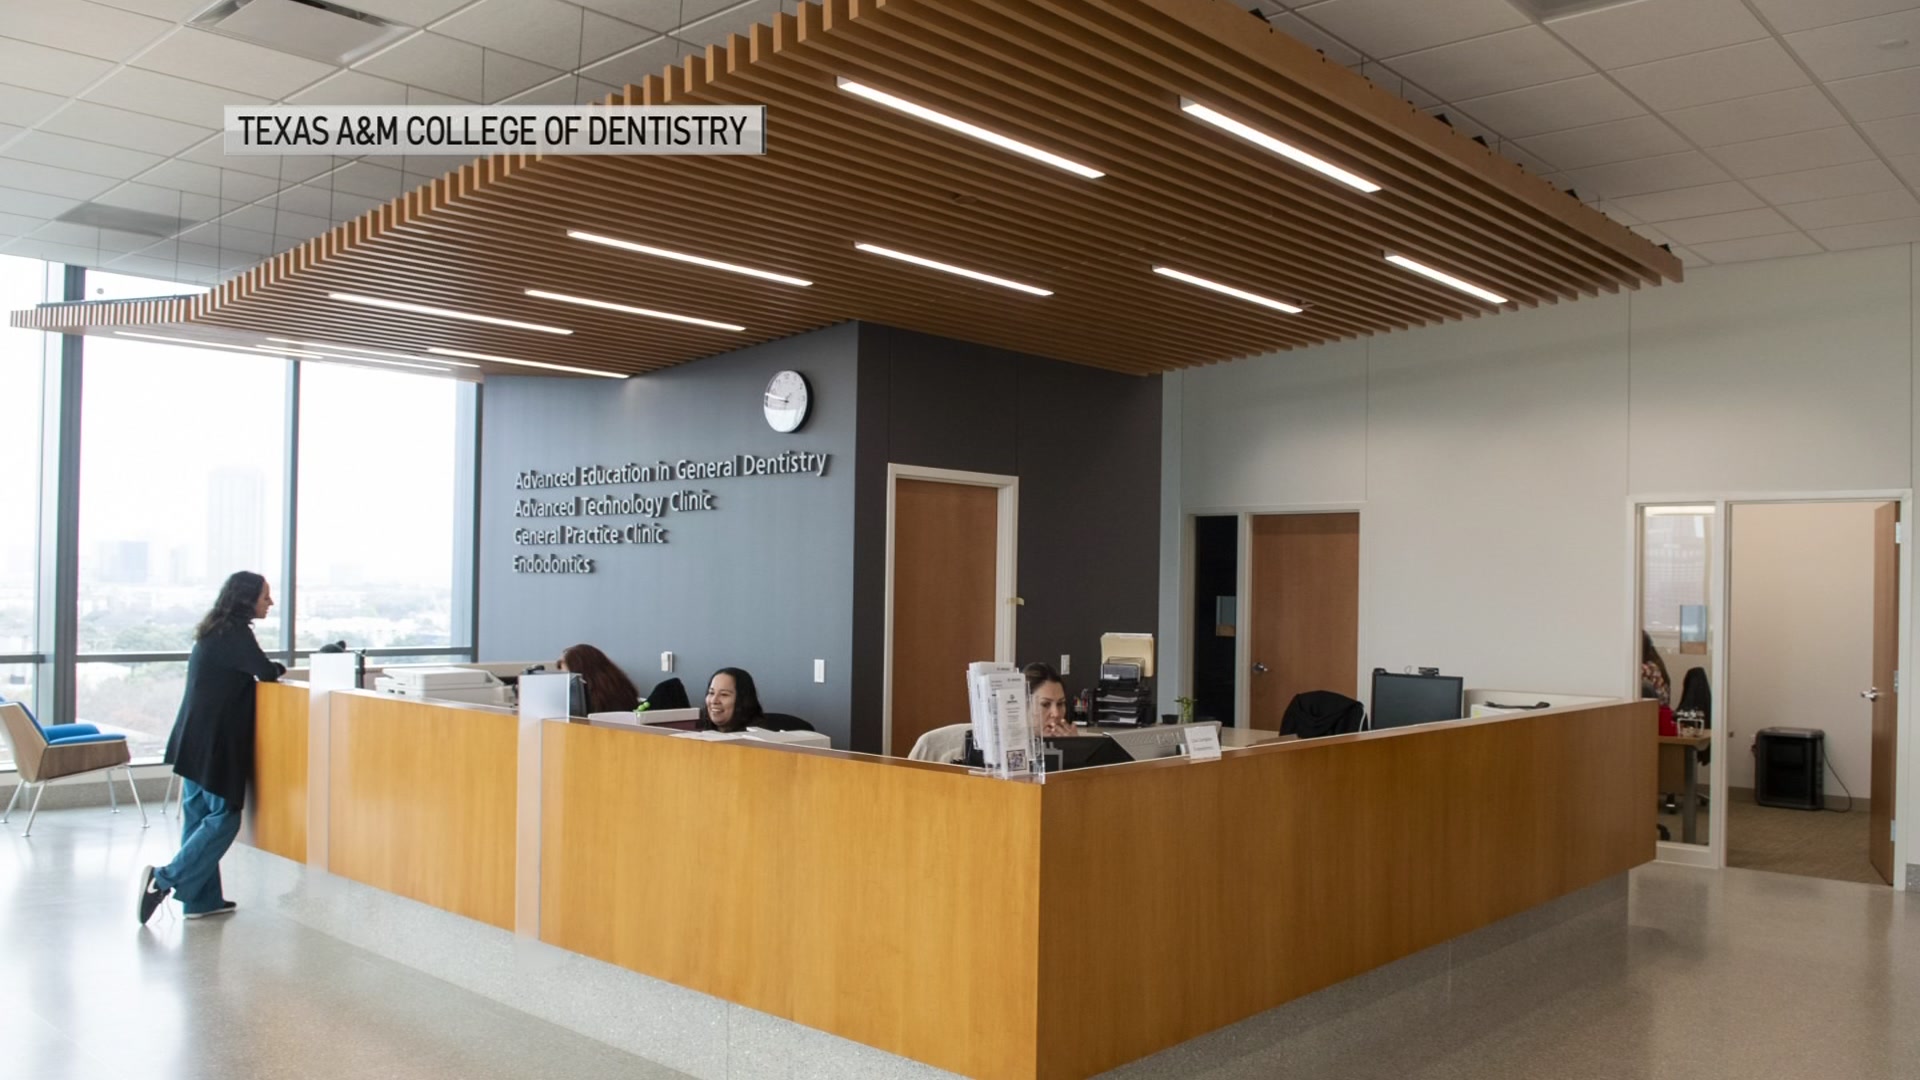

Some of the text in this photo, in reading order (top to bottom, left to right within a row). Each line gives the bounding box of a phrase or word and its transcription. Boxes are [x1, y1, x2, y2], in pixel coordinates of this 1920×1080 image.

[515, 450, 827, 489] Advanced Education in General Dentistry
[514, 489, 713, 518] Advanced Technology Clinic
[513, 522, 665, 544] General Practice Clinic
[512, 554, 592, 573] Endodontics
